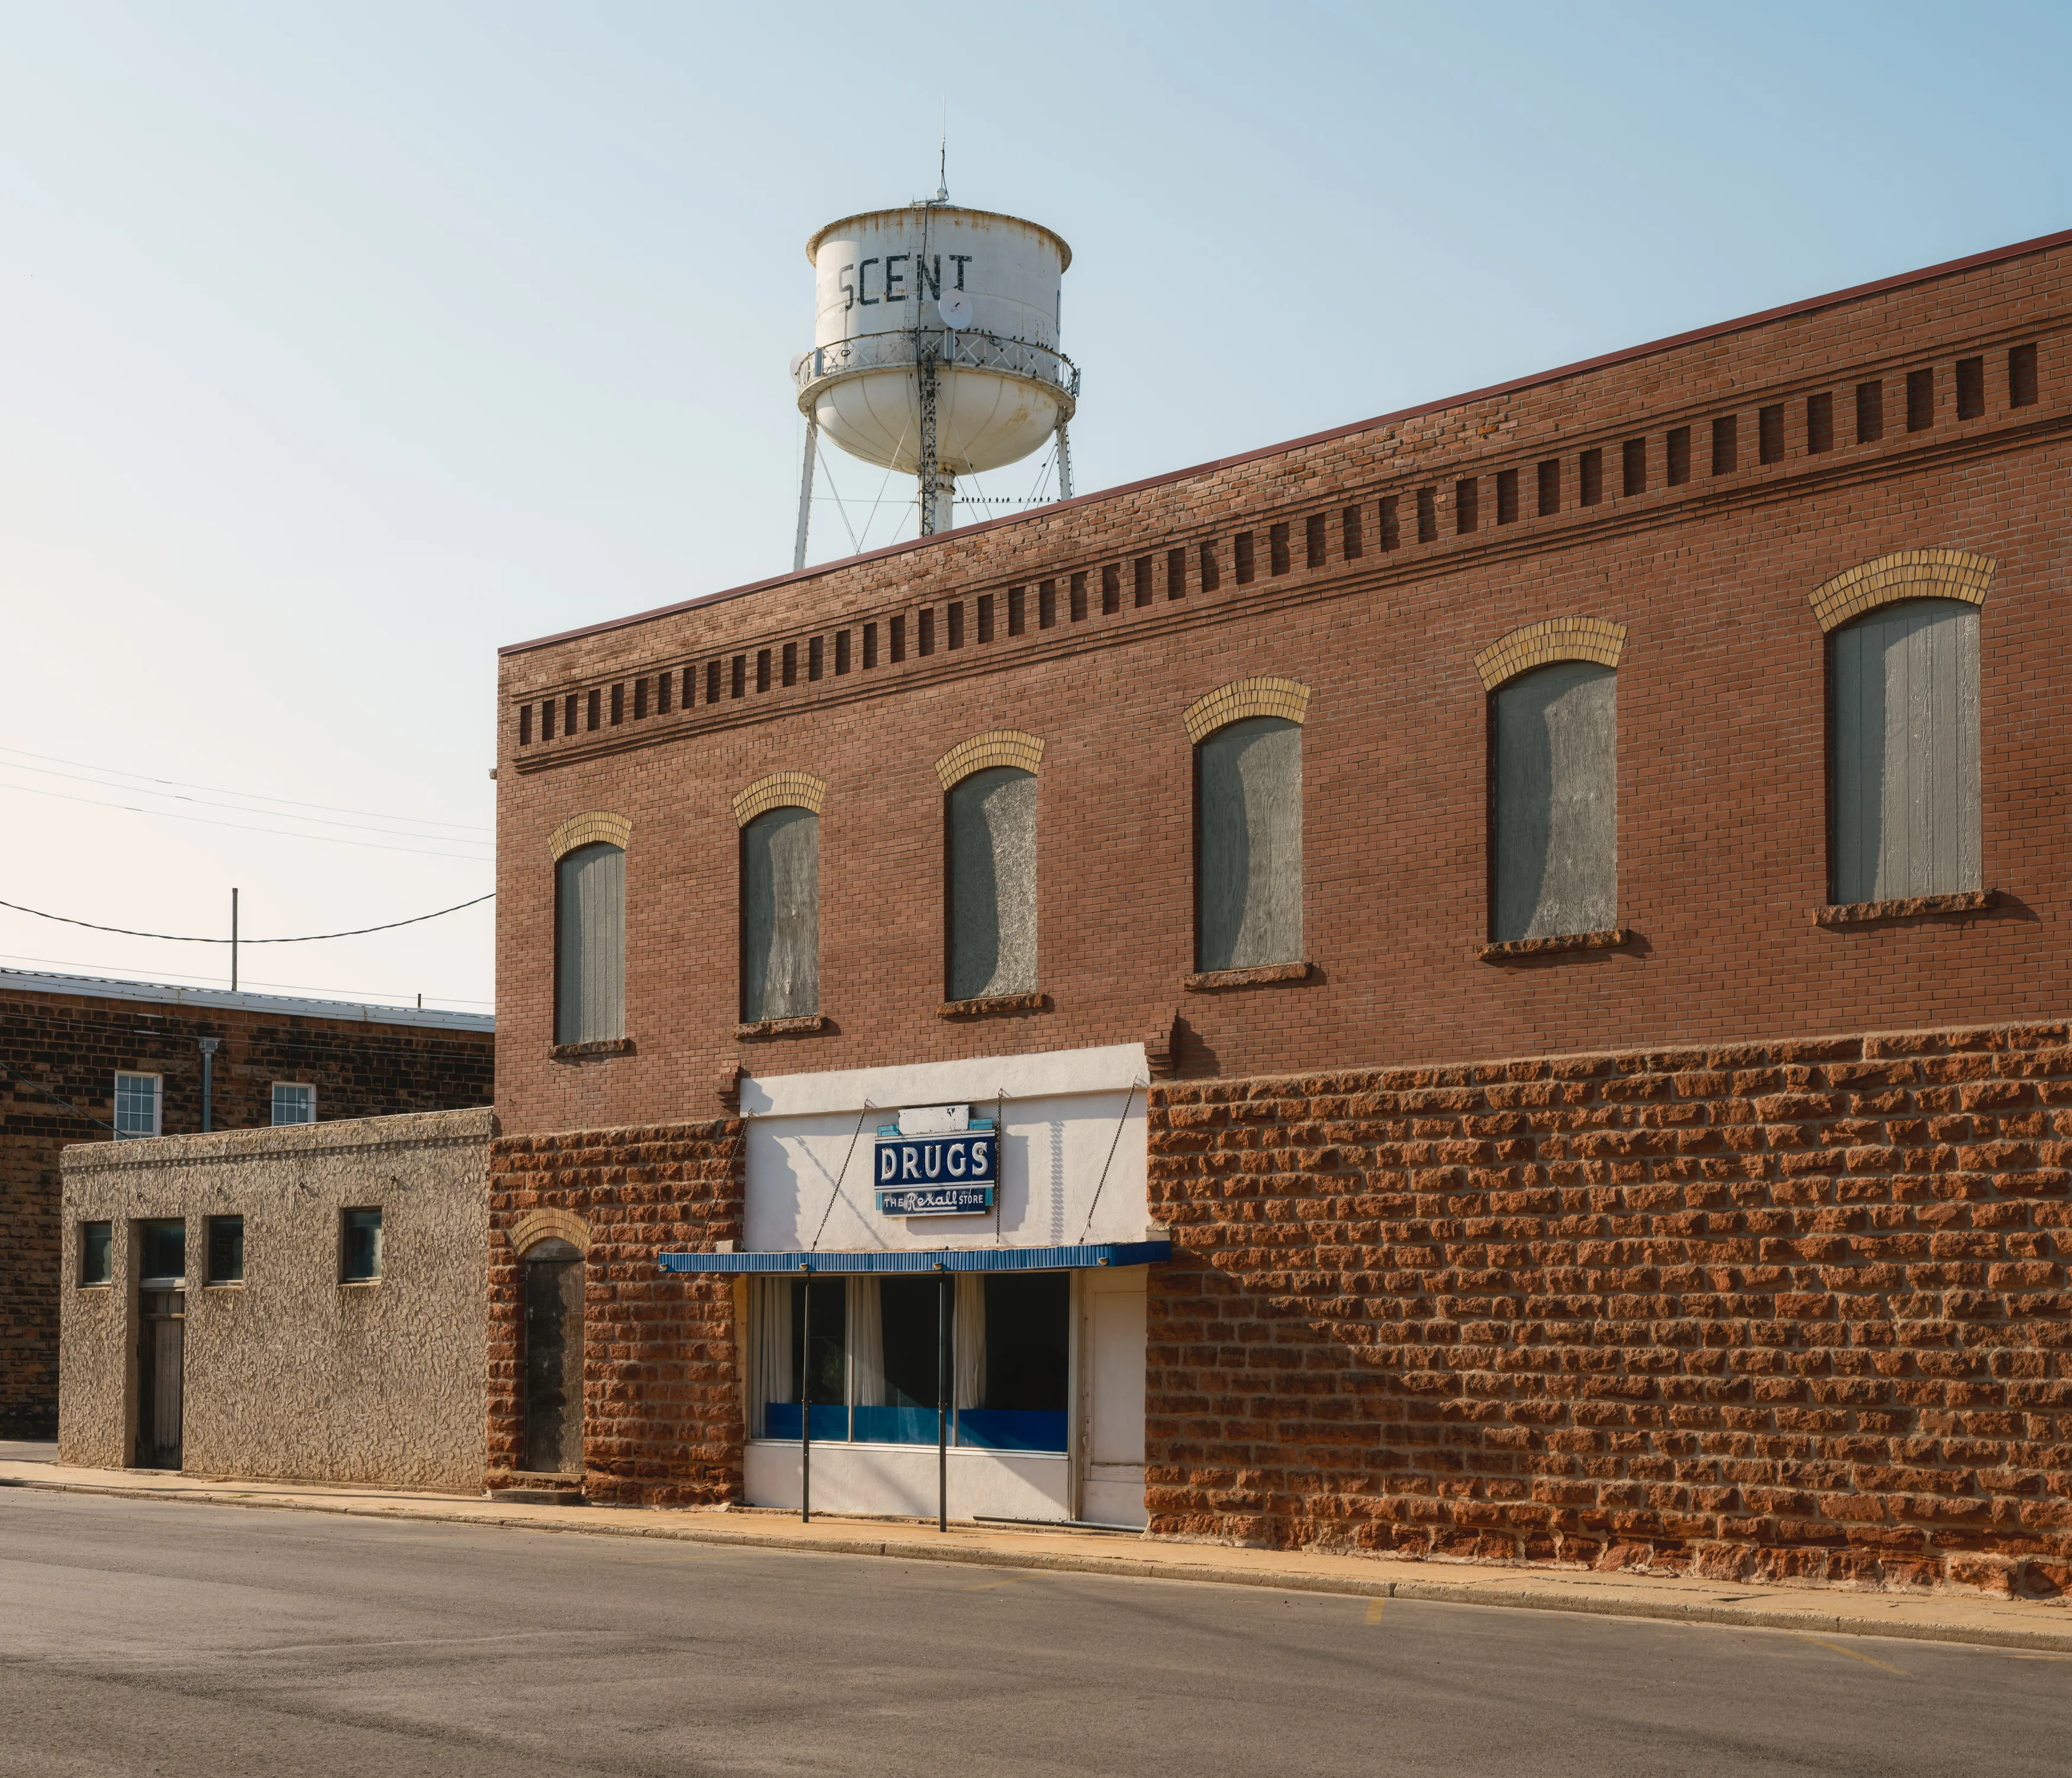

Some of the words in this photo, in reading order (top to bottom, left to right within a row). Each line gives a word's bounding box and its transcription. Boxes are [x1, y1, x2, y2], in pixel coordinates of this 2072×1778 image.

[881, 1142, 988, 1180] DRUGS
[884, 1198, 903, 1207] THE
[907, 1190, 957, 1211] Rexall
[958, 1194, 983, 1204] STORE
